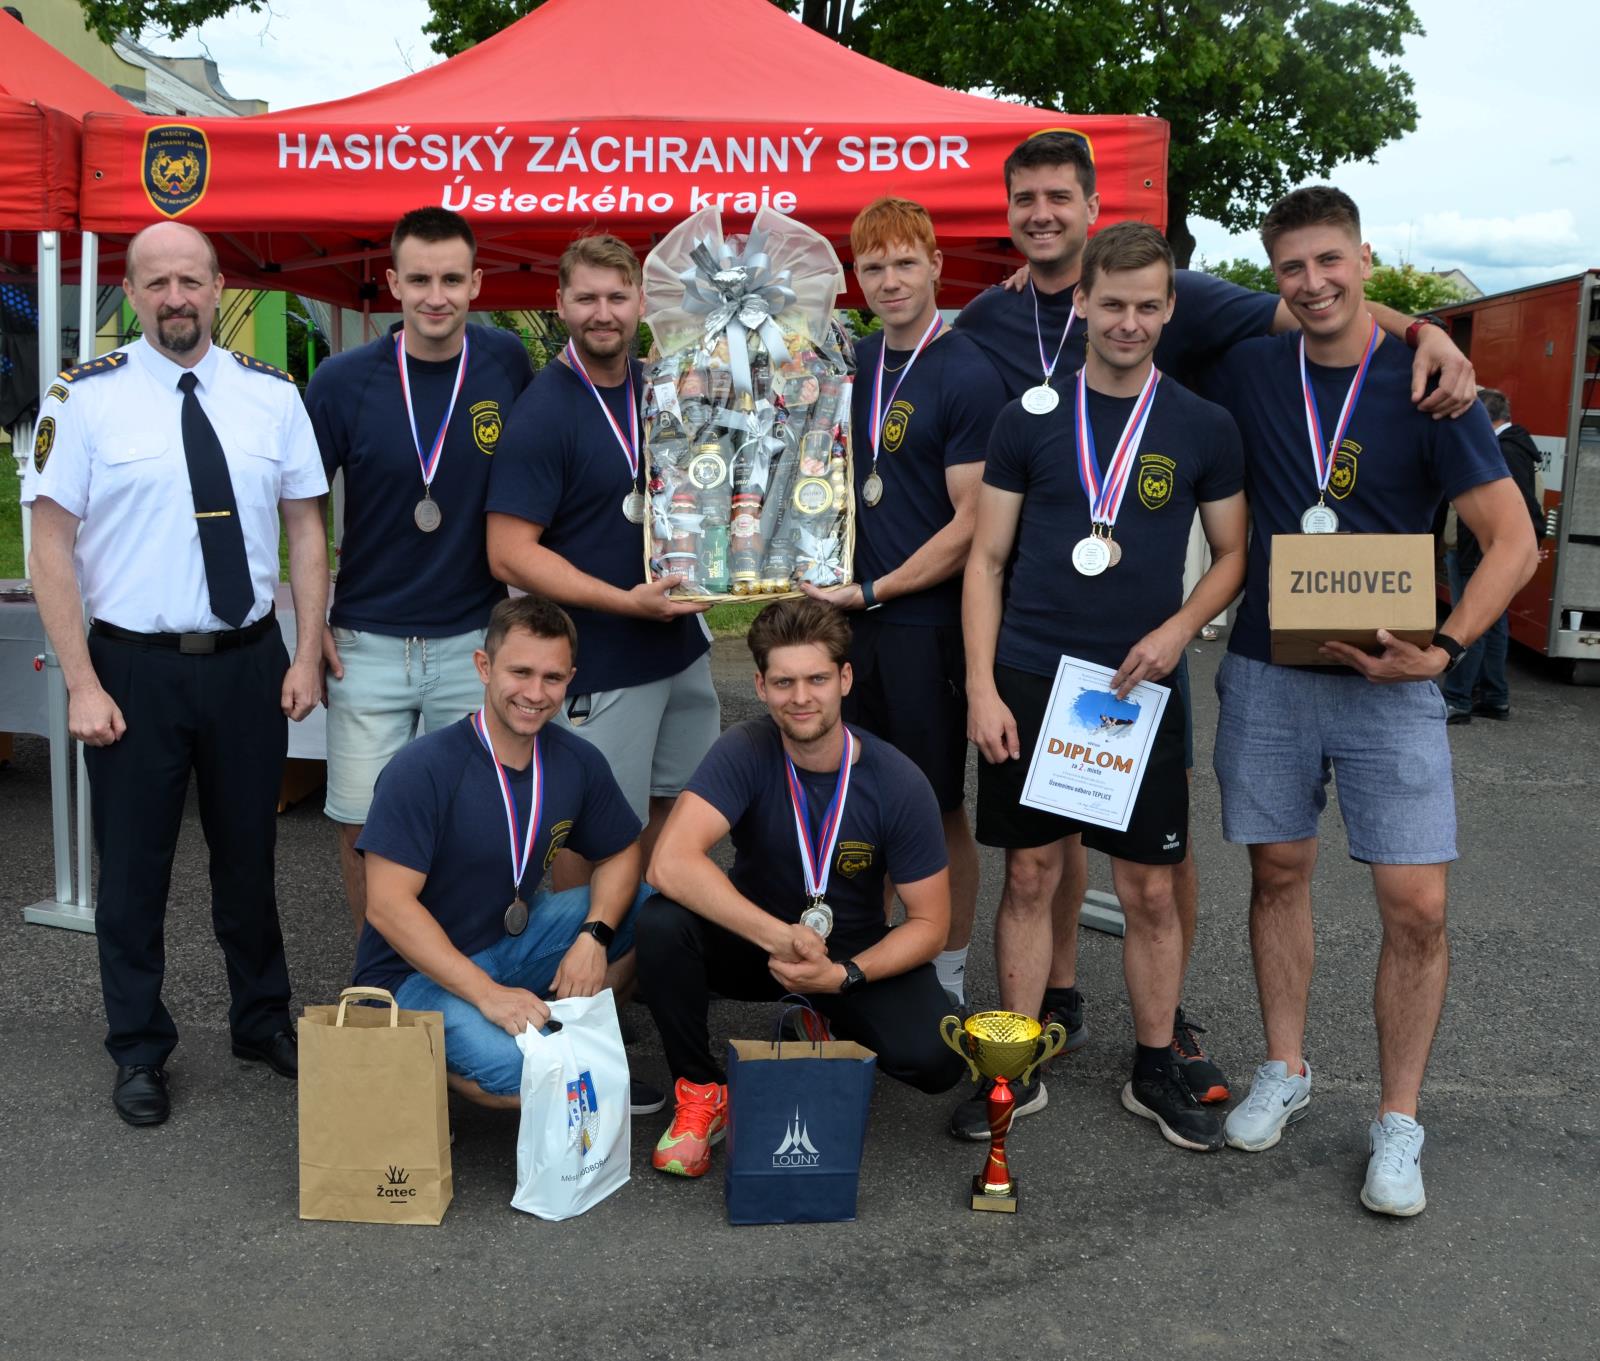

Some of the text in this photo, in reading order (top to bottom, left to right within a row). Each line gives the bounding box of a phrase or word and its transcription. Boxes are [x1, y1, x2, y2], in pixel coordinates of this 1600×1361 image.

[277, 126, 970, 174] HASIČSKÝ ZÁCHRANNÝ SBOR
[441, 175, 798, 214] Ústeckého kraje
[1290, 570, 1412, 594] ZICHOVEC
[1047, 738, 1134, 774] DIPLOM
[1092, 790, 1112, 801] TEPLICE
[772, 1154, 820, 1166] LOUNY
[376, 1184, 417, 1198] Žatec
